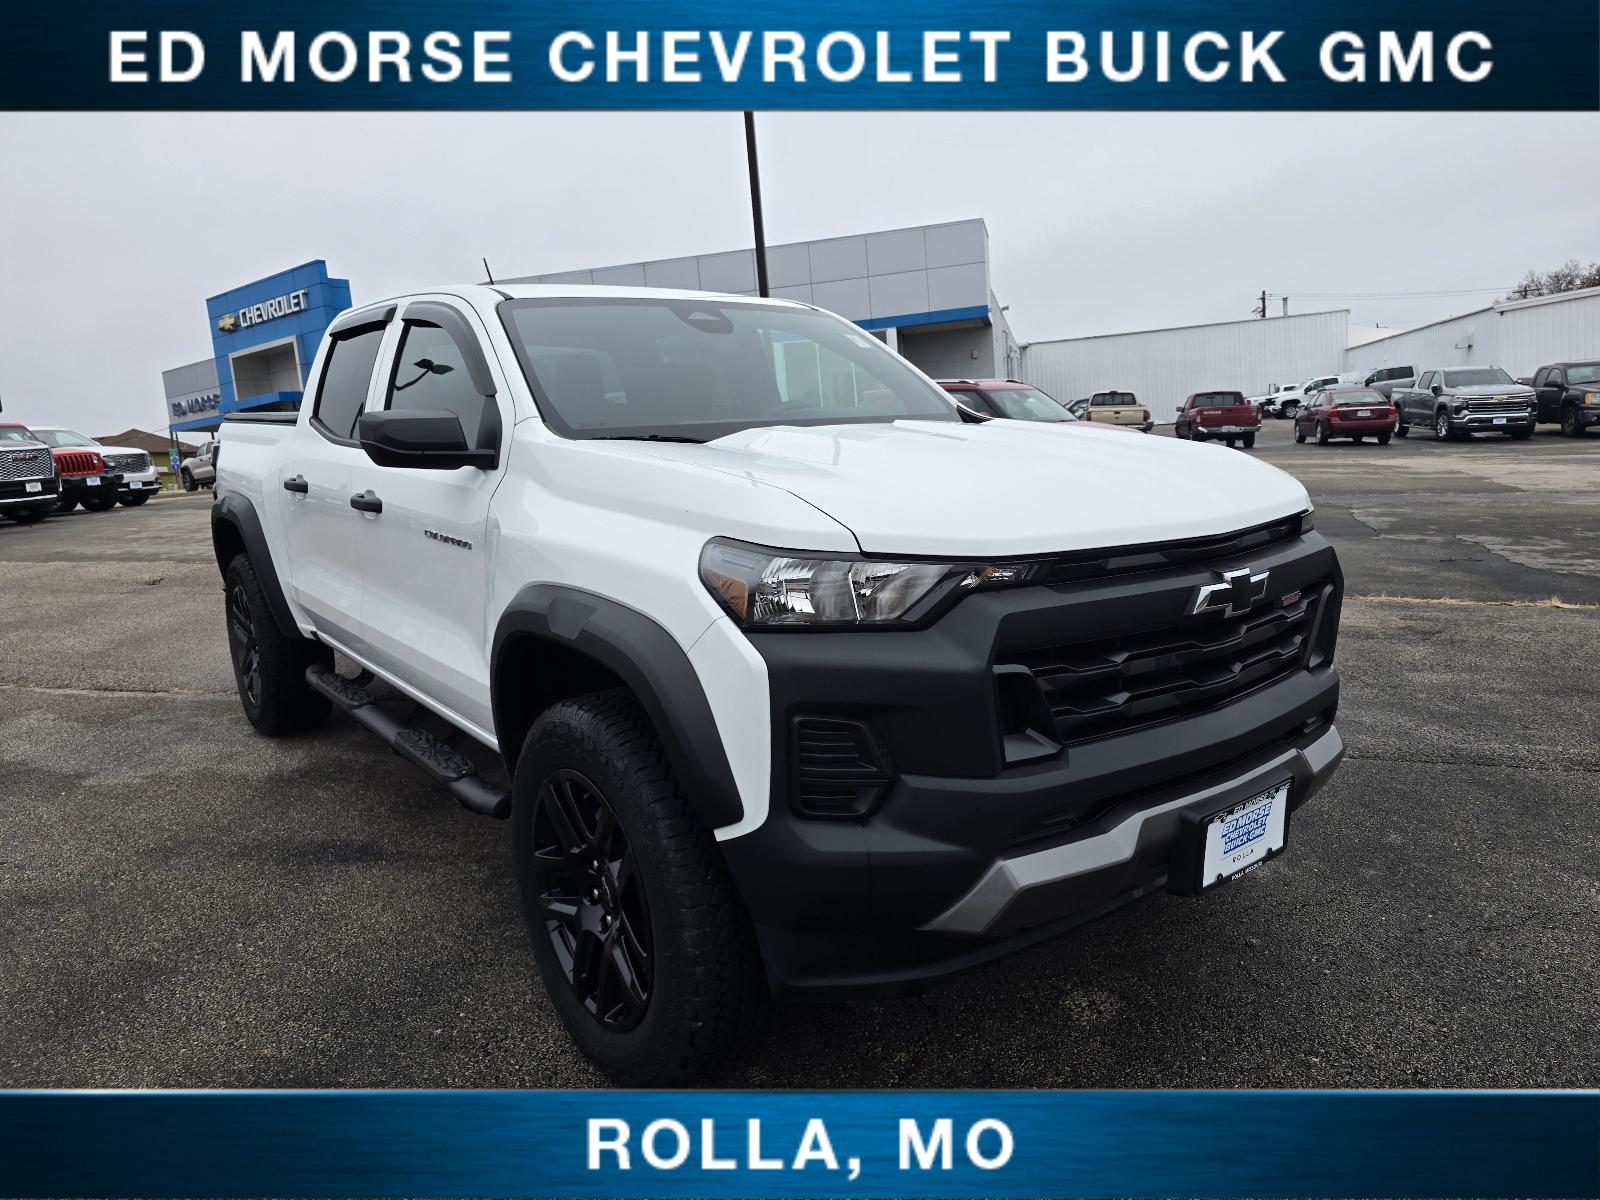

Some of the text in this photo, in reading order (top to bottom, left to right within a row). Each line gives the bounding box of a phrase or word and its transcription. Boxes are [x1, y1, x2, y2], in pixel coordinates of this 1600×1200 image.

[239, 289, 306, 328] CHEVROLET
[1222, 803, 1272, 834] ED MORSE
[1225, 816, 1267, 842] CHEVROLET
[1232, 849, 1254, 862] ROLLA
